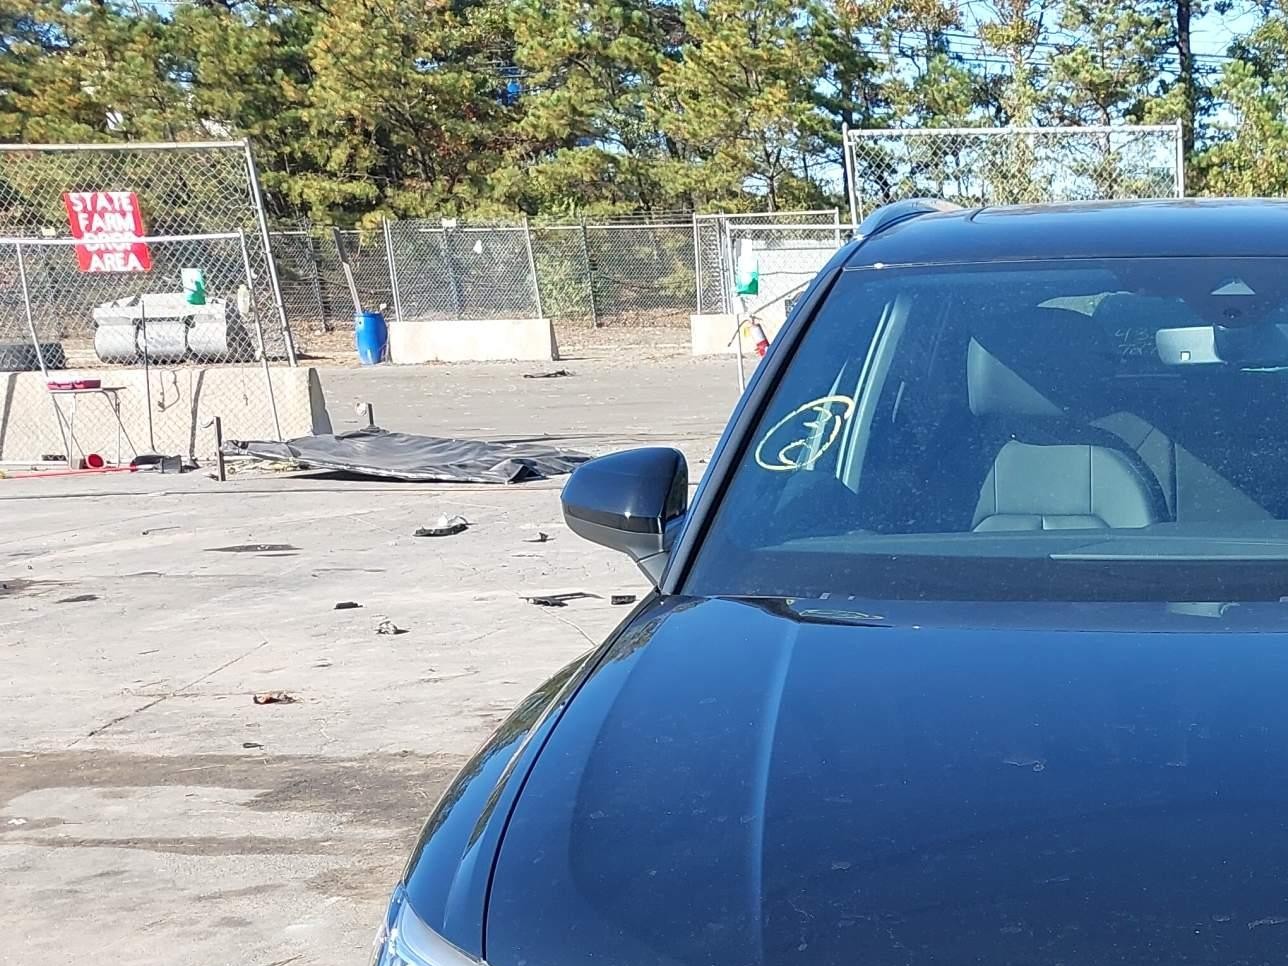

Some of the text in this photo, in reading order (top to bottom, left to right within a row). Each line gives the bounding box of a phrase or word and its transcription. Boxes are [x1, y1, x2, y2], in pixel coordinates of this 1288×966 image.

[68, 191, 134, 212] STATE
[77, 211, 136, 232] FARM
[88, 251, 146, 272] AREA
